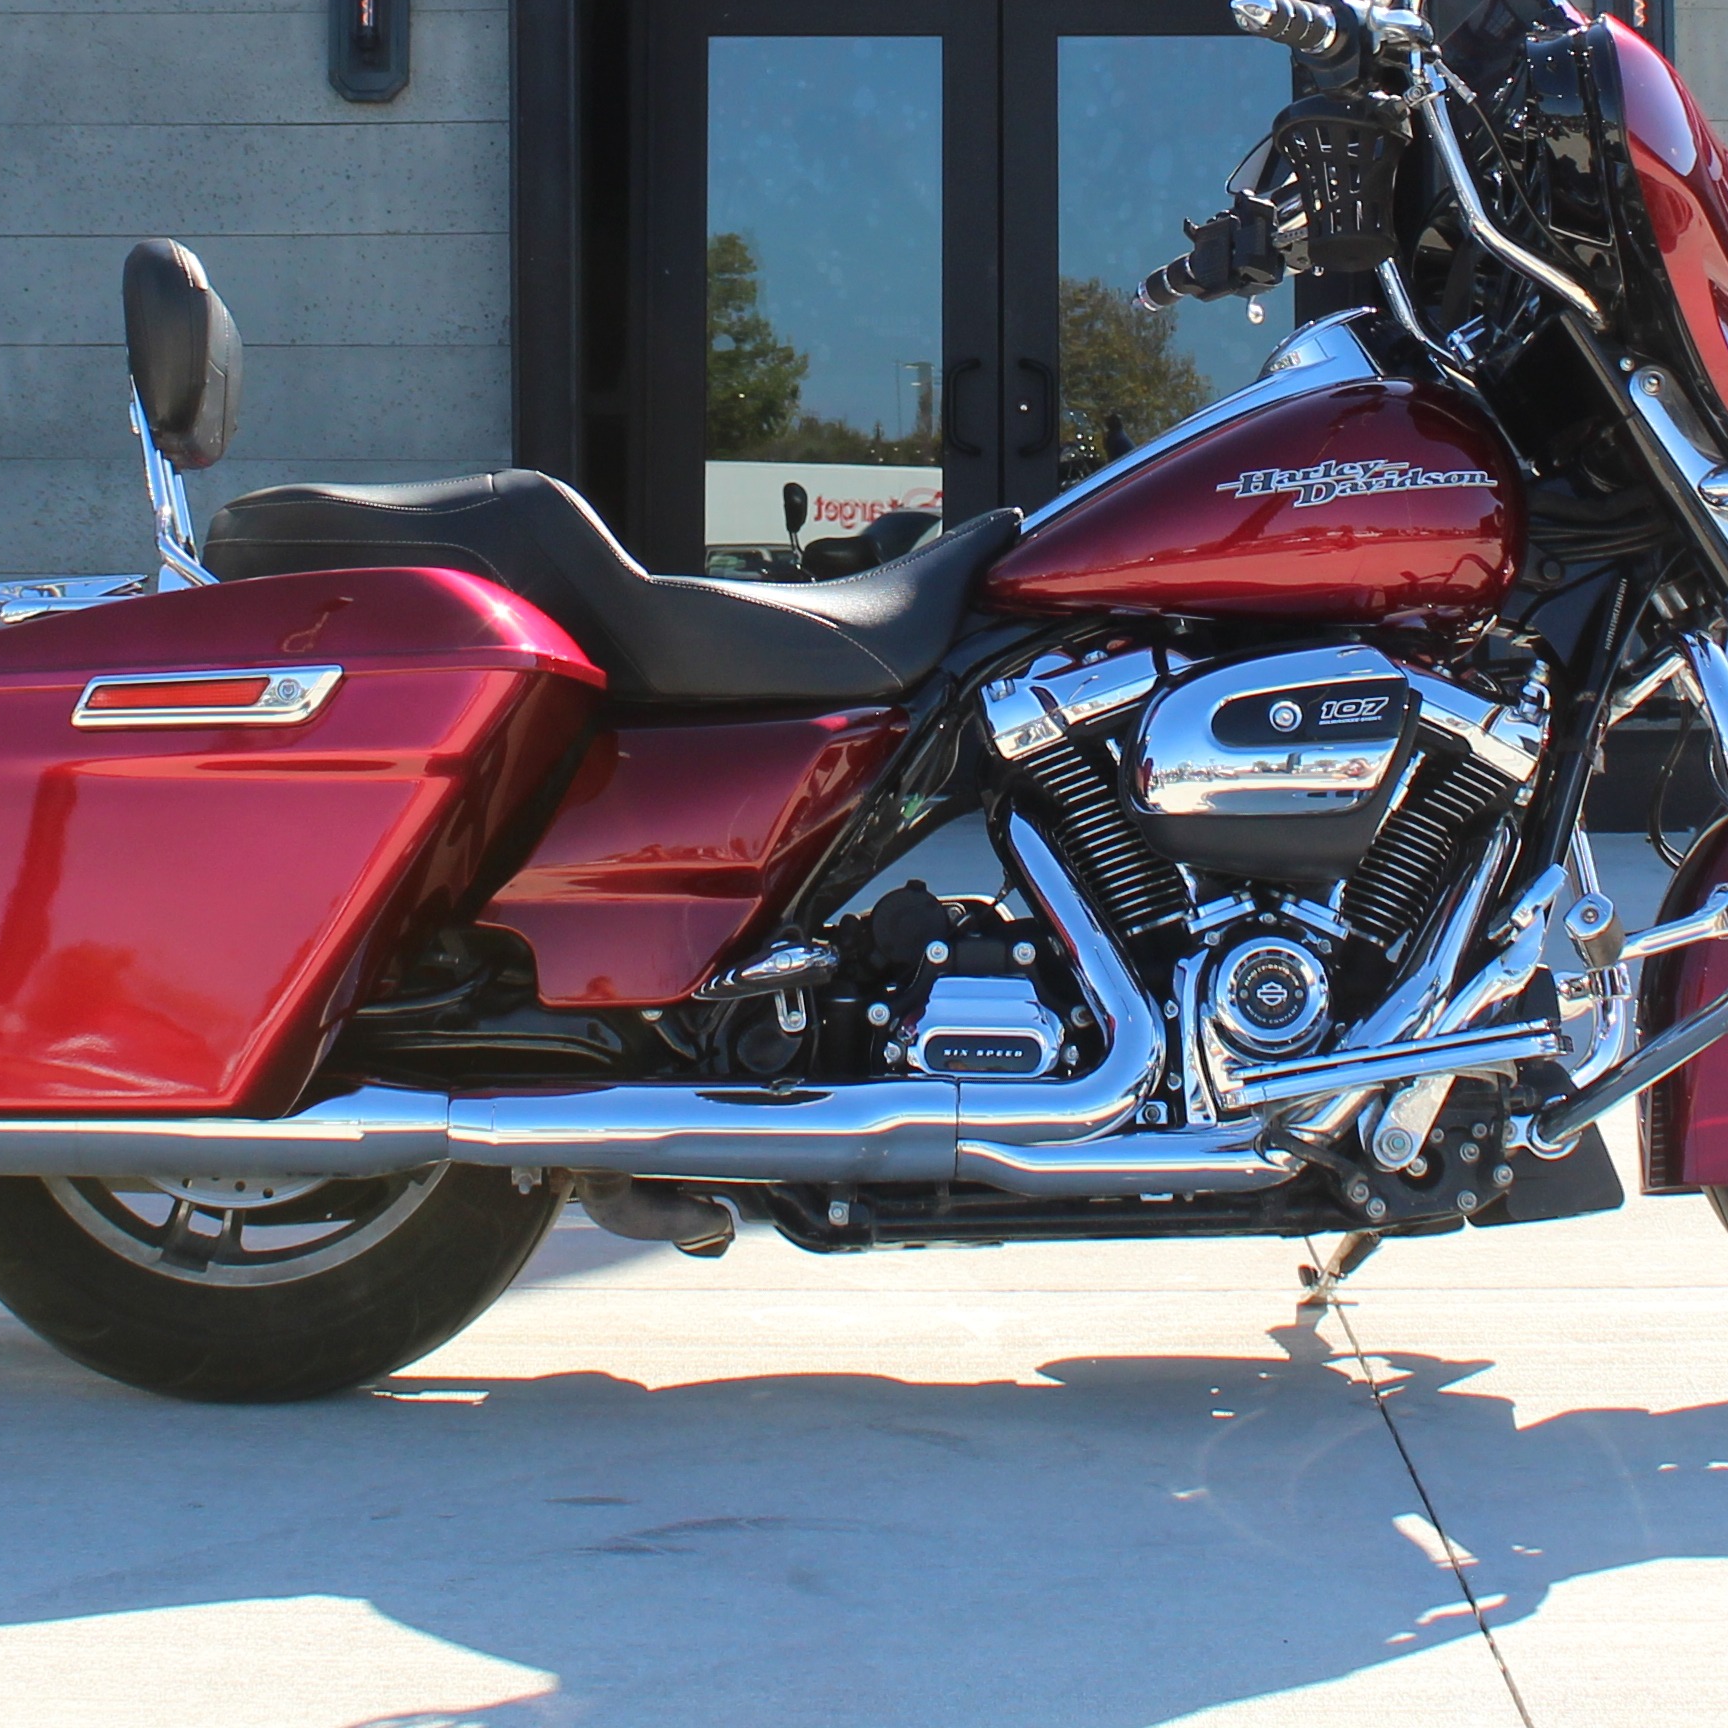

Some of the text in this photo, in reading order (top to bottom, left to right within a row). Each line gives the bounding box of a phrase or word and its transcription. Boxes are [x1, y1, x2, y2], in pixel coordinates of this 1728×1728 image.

[1292, 468, 1499, 508] Davidson
[1320, 696, 1390, 720] 107
[943, 1048, 1024, 1058] SIX SPEED
